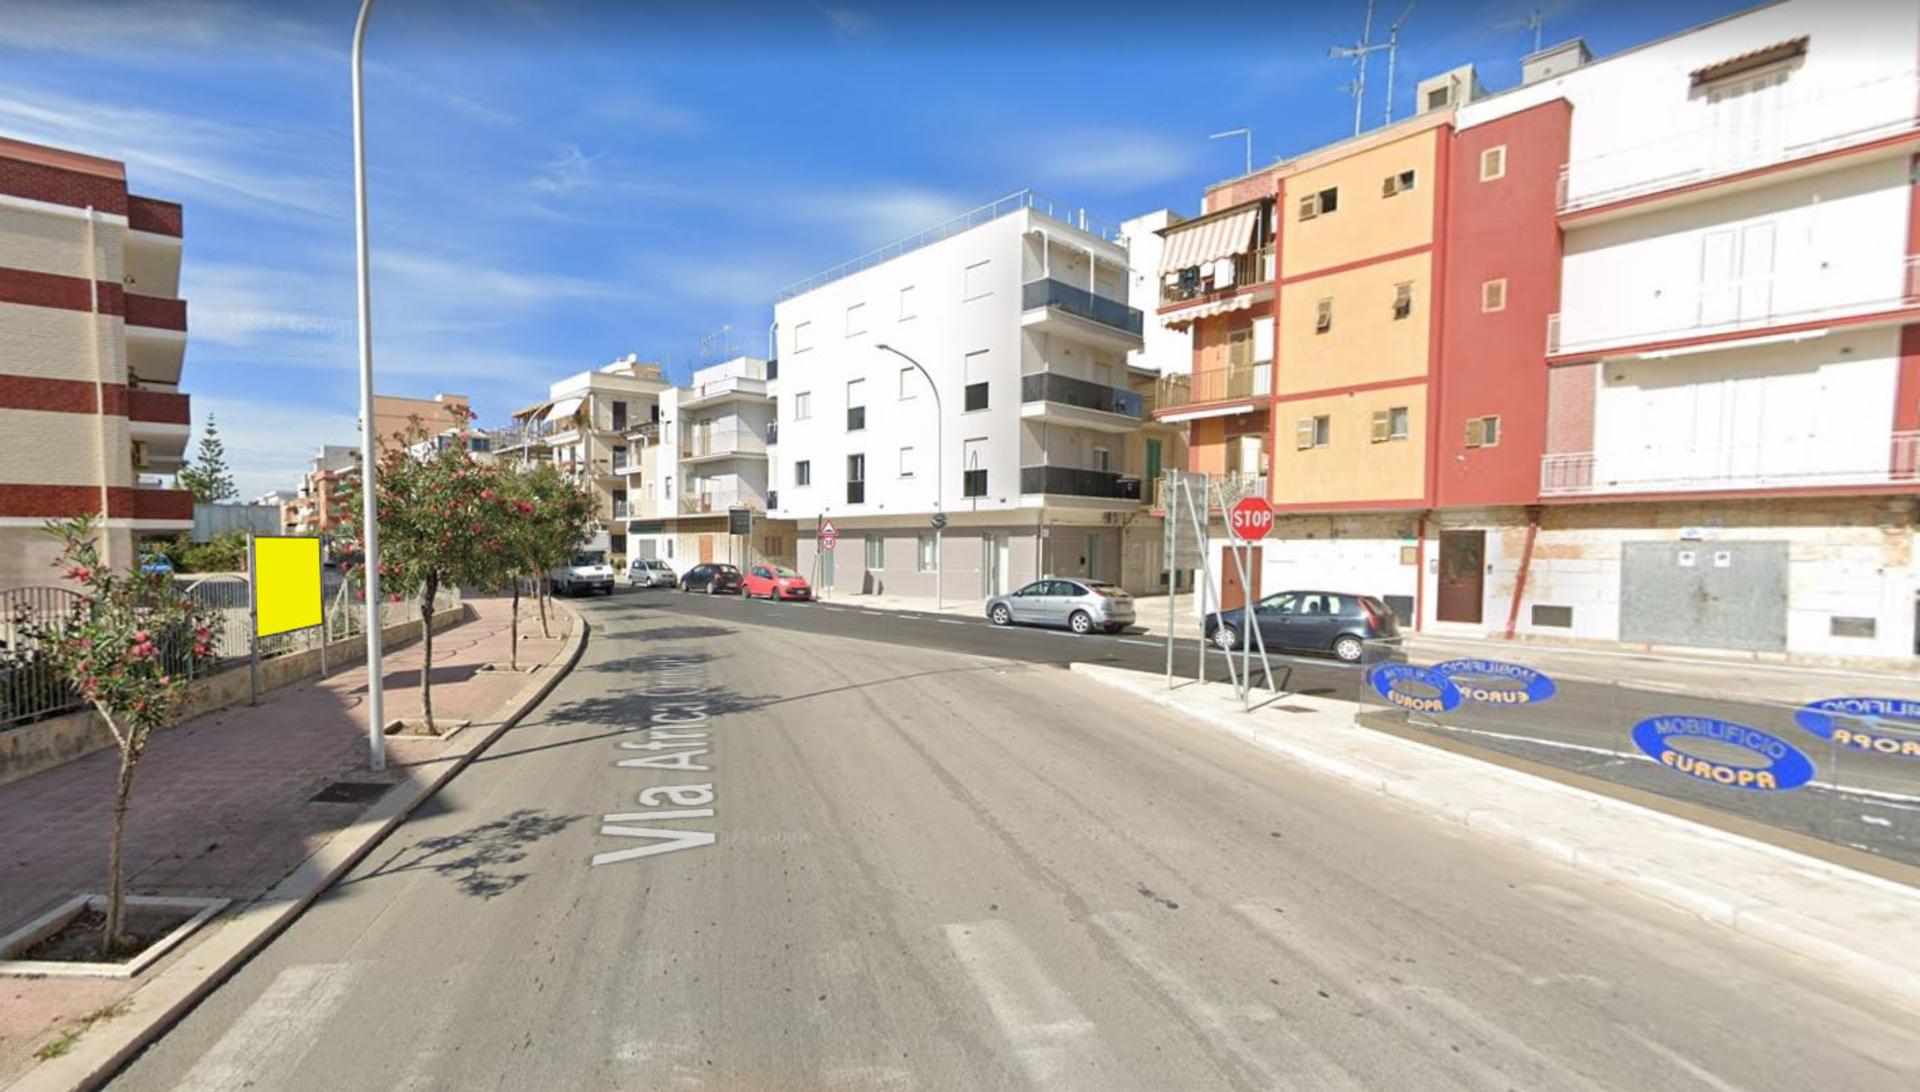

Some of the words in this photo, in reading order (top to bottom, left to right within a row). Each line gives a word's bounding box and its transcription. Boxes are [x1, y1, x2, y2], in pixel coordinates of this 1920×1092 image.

[1233, 510, 1272, 527] STOP
[1387, 690, 1443, 712] EUROPA
[1654, 717, 1786, 759] MOBILIFICIO
[1661, 750, 1776, 789] EUROPA
